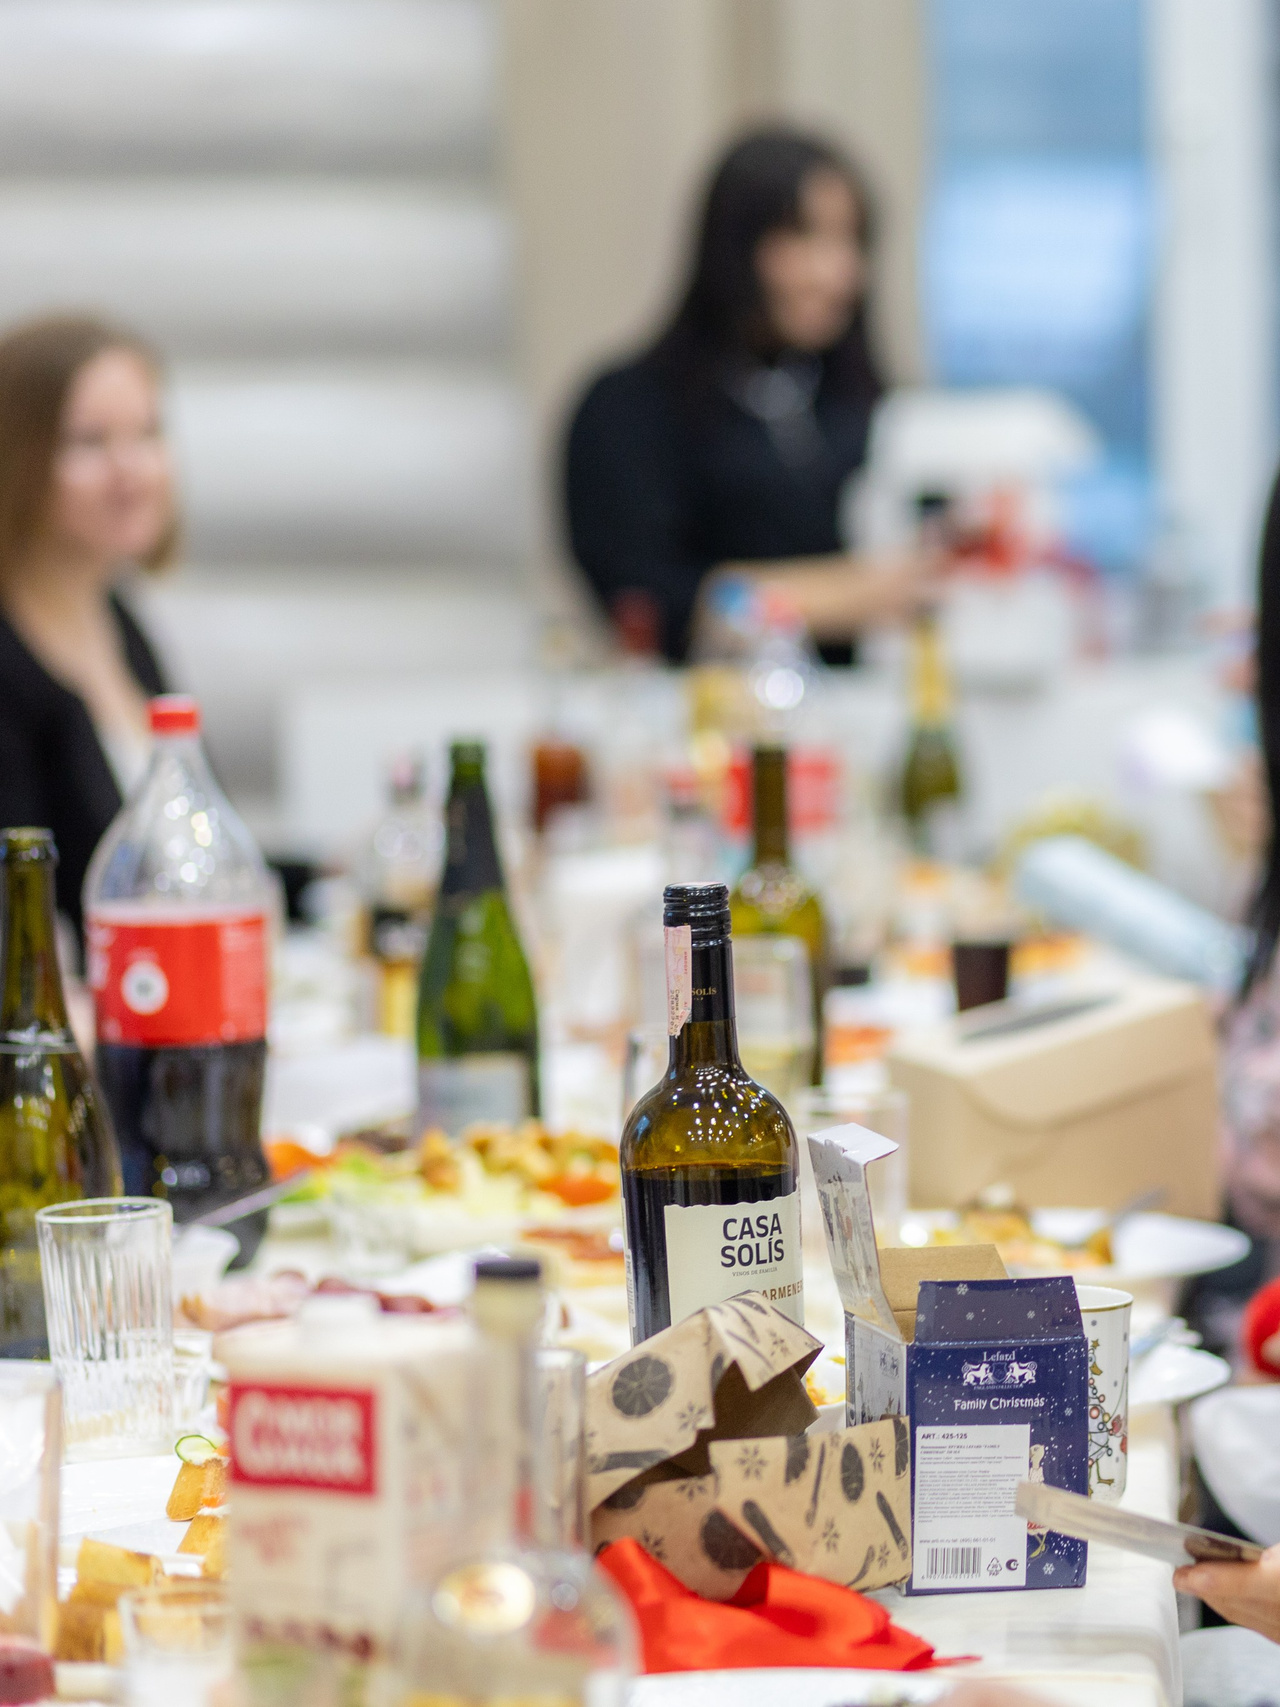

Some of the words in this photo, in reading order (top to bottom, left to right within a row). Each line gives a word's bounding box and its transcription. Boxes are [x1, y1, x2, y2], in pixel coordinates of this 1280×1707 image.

[722, 1212, 782, 1241] CASA
[720, 1237, 785, 1268] SOLÍS
[983, 1350, 1016, 1361] Lefard
[953, 1398, 988, 1411] Family
[990, 1396, 1045, 1411] Christmas
[941, 1432, 968, 1440] 425-125
